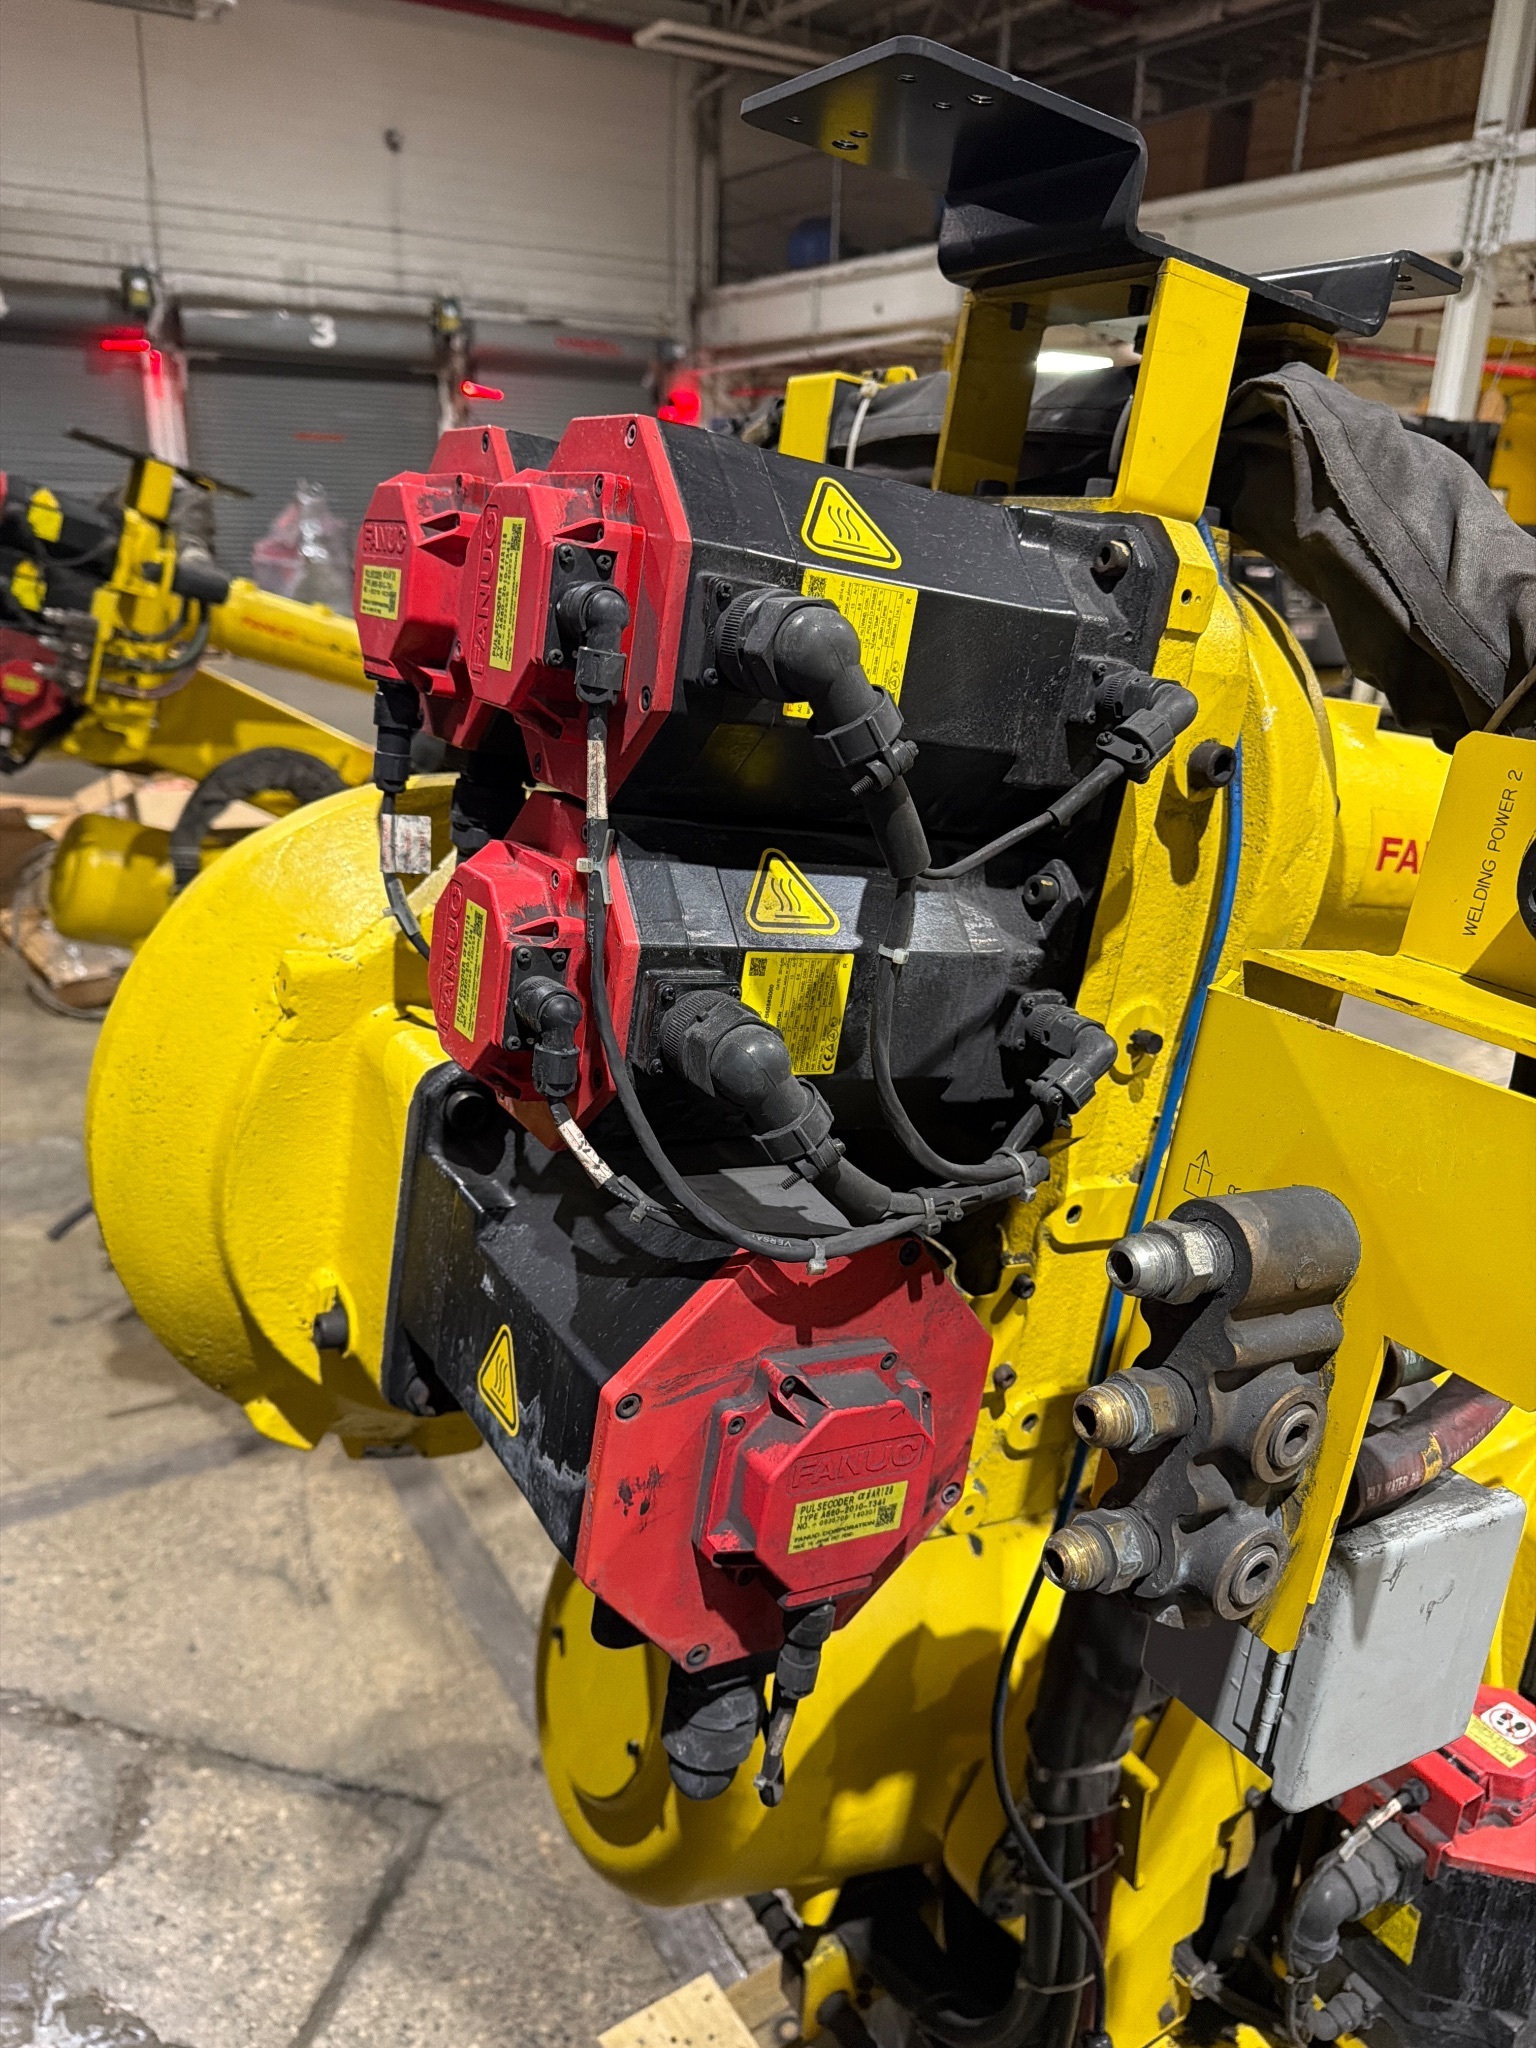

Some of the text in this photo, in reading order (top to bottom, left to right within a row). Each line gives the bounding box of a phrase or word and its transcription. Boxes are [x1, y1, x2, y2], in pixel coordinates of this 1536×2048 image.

[309, 314, 336, 348] 3
[470, 511, 497, 681] FANUC
[1376, 837, 1428, 875] FA
[1461, 769, 1524, 936] WELDING POWER 2
[437, 886, 462, 1038] FANUC
[792, 1444, 918, 1488] FANUC
[798, 1512, 818, 1523] TYPE
[799, 1495, 854, 1515] PULSECODER
